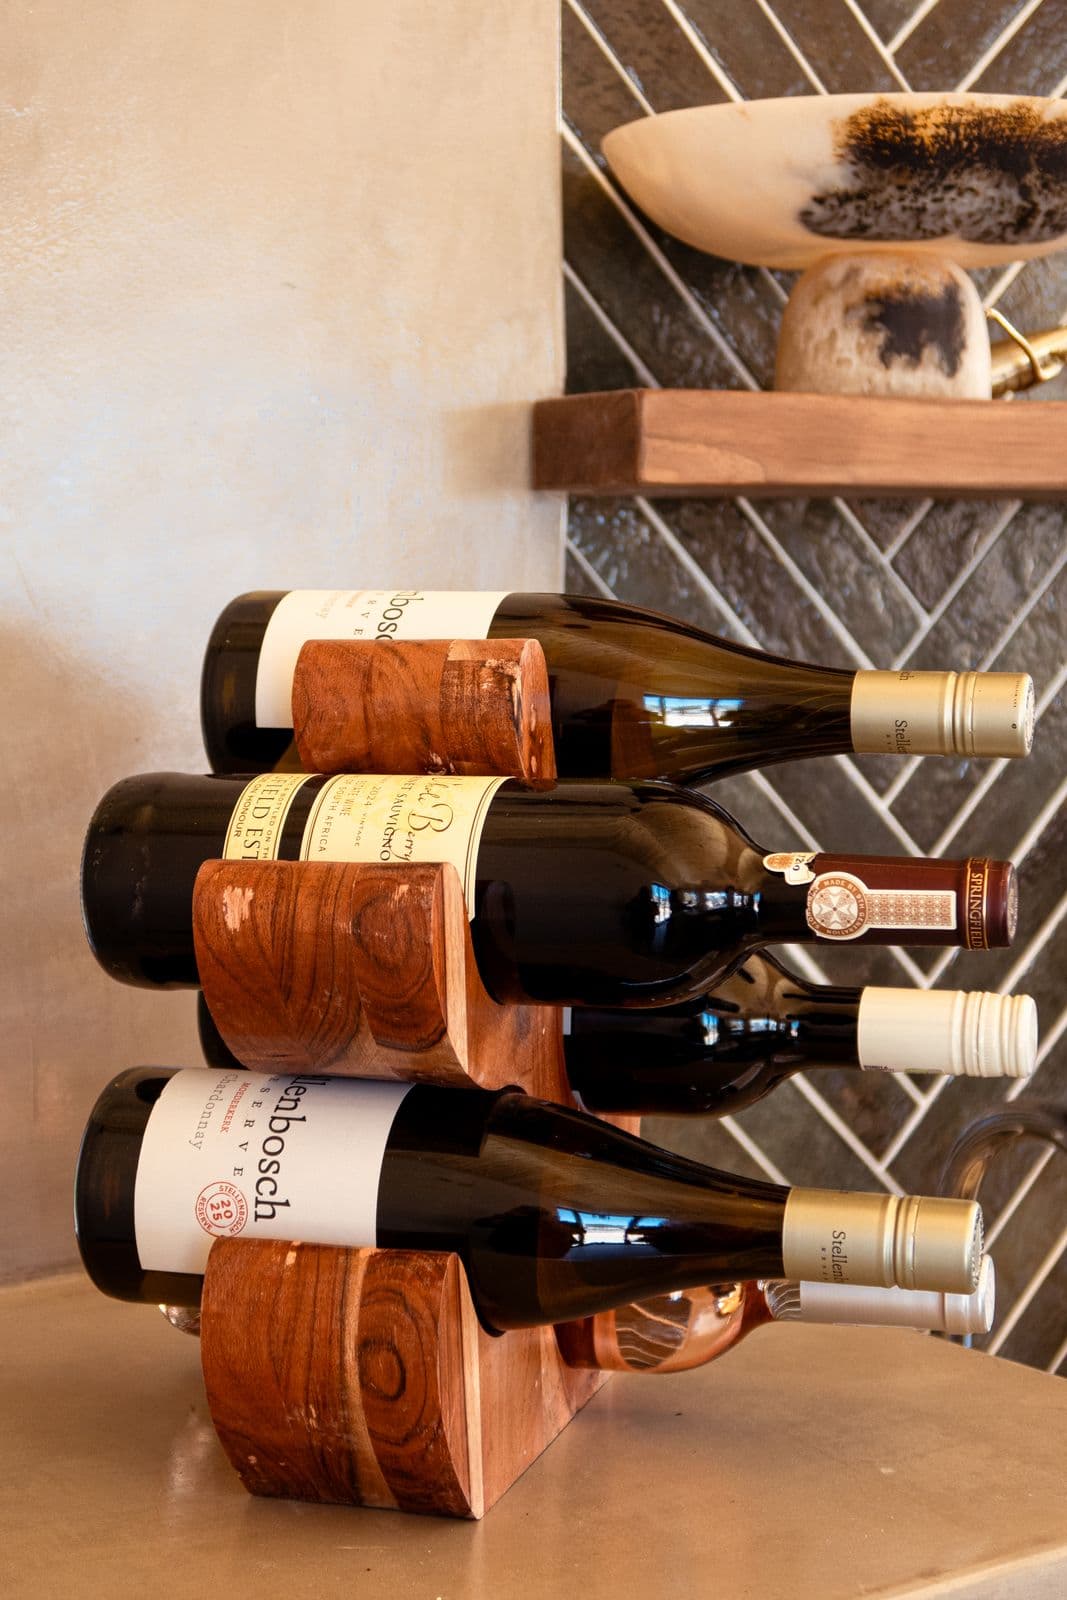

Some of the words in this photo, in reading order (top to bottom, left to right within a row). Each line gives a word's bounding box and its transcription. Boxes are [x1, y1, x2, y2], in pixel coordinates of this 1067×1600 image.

[318, 815, 334, 853] AFRICA
[197, 1197, 213, 1231] RESERVE
[209, 1203, 223, 1221] 25
[219, 1185, 245, 1233] STELLENBOSCH
[220, 1199, 233, 1219] 20
